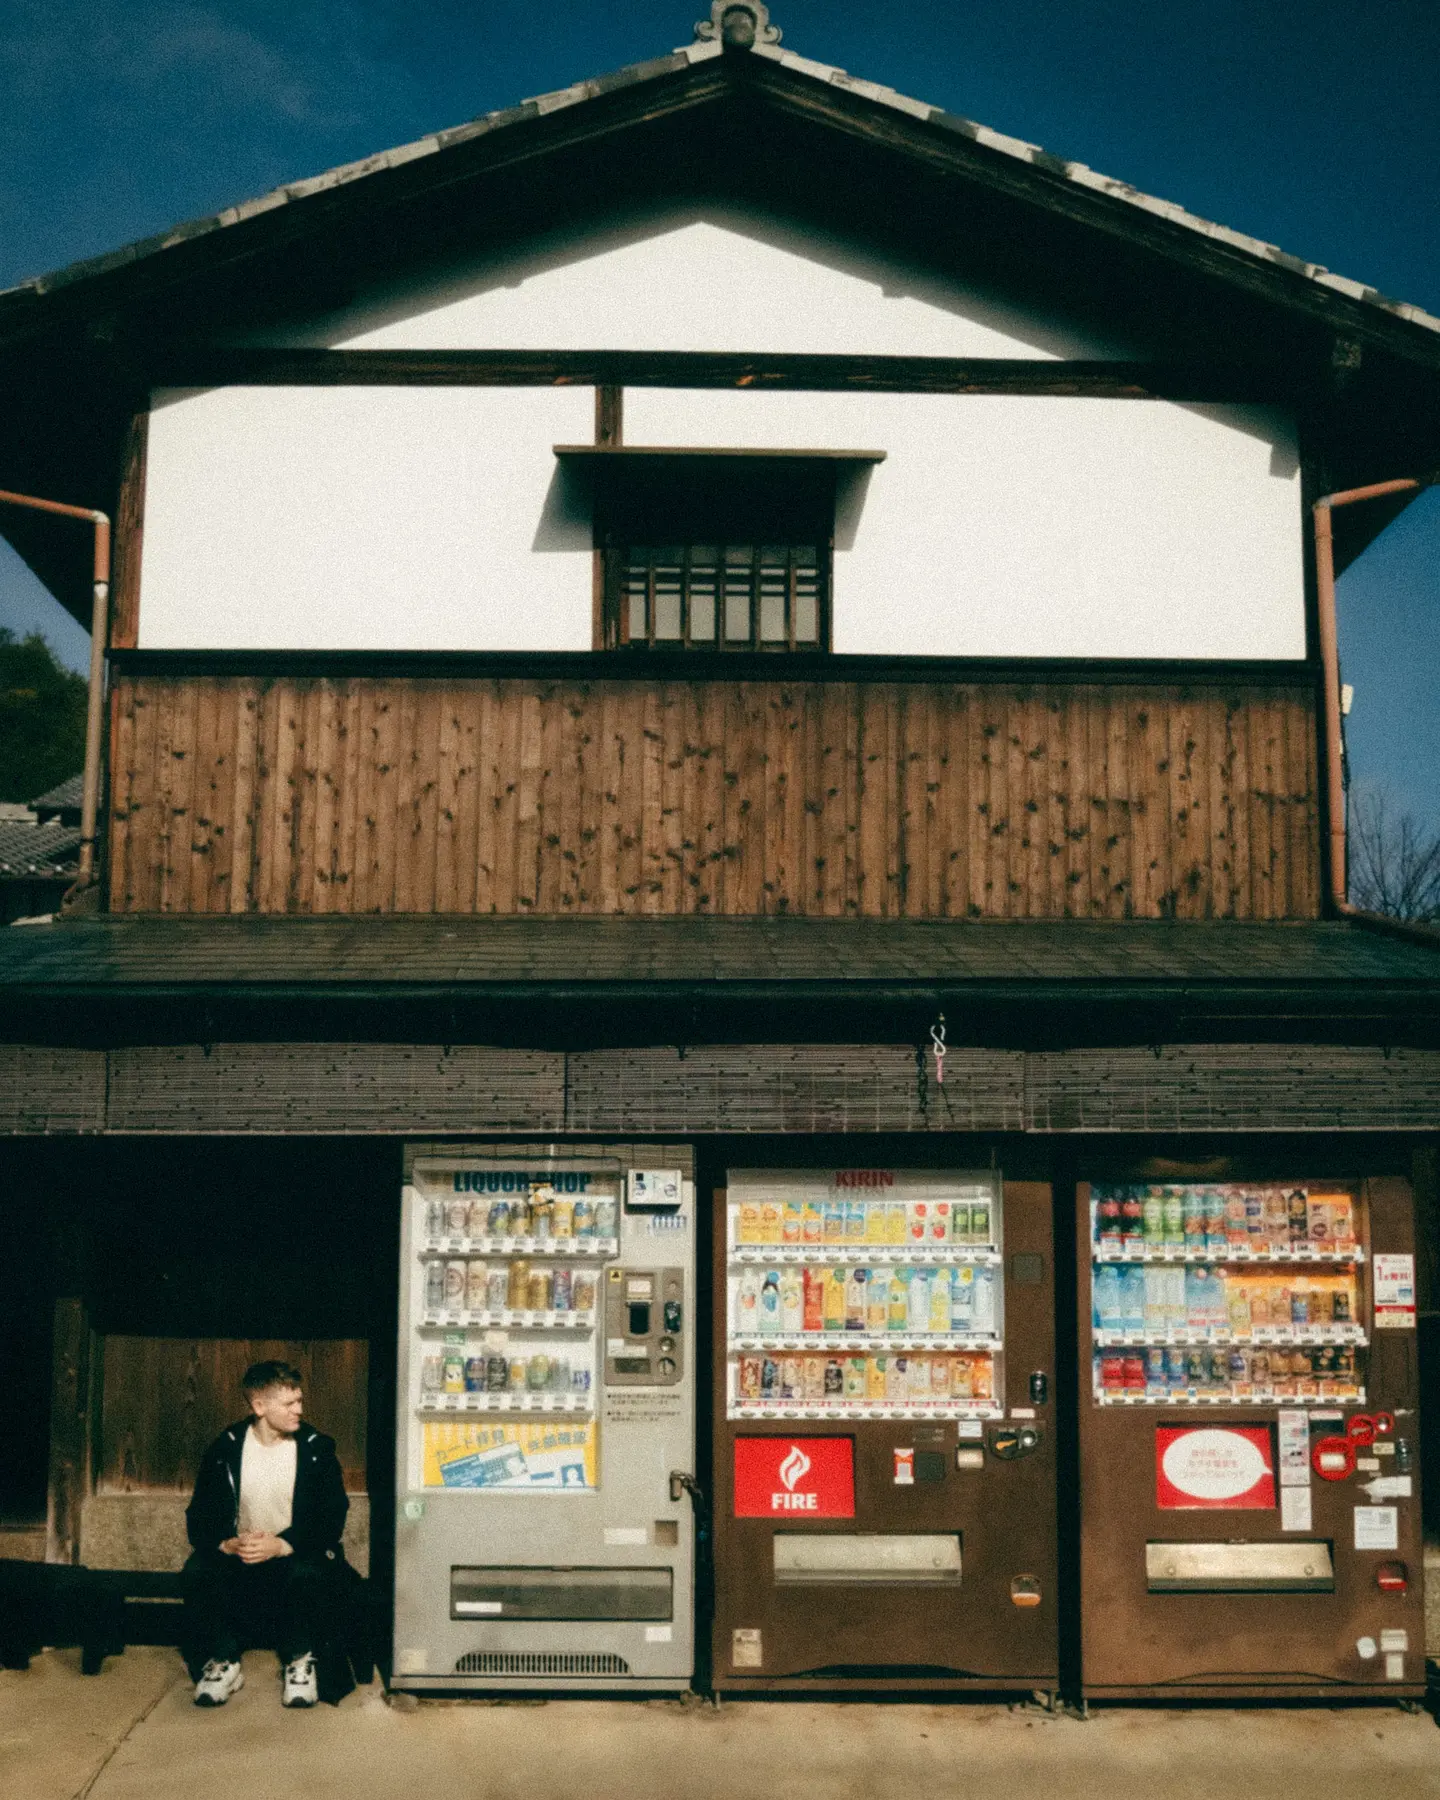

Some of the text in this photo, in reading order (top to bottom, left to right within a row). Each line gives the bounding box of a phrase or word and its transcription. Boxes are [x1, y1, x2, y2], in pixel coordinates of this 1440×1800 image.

[453, 1171, 529, 1194] LIQUOR
[835, 1170, 893, 1187] KIRIN
[771, 1492, 818, 1510] FIRE
